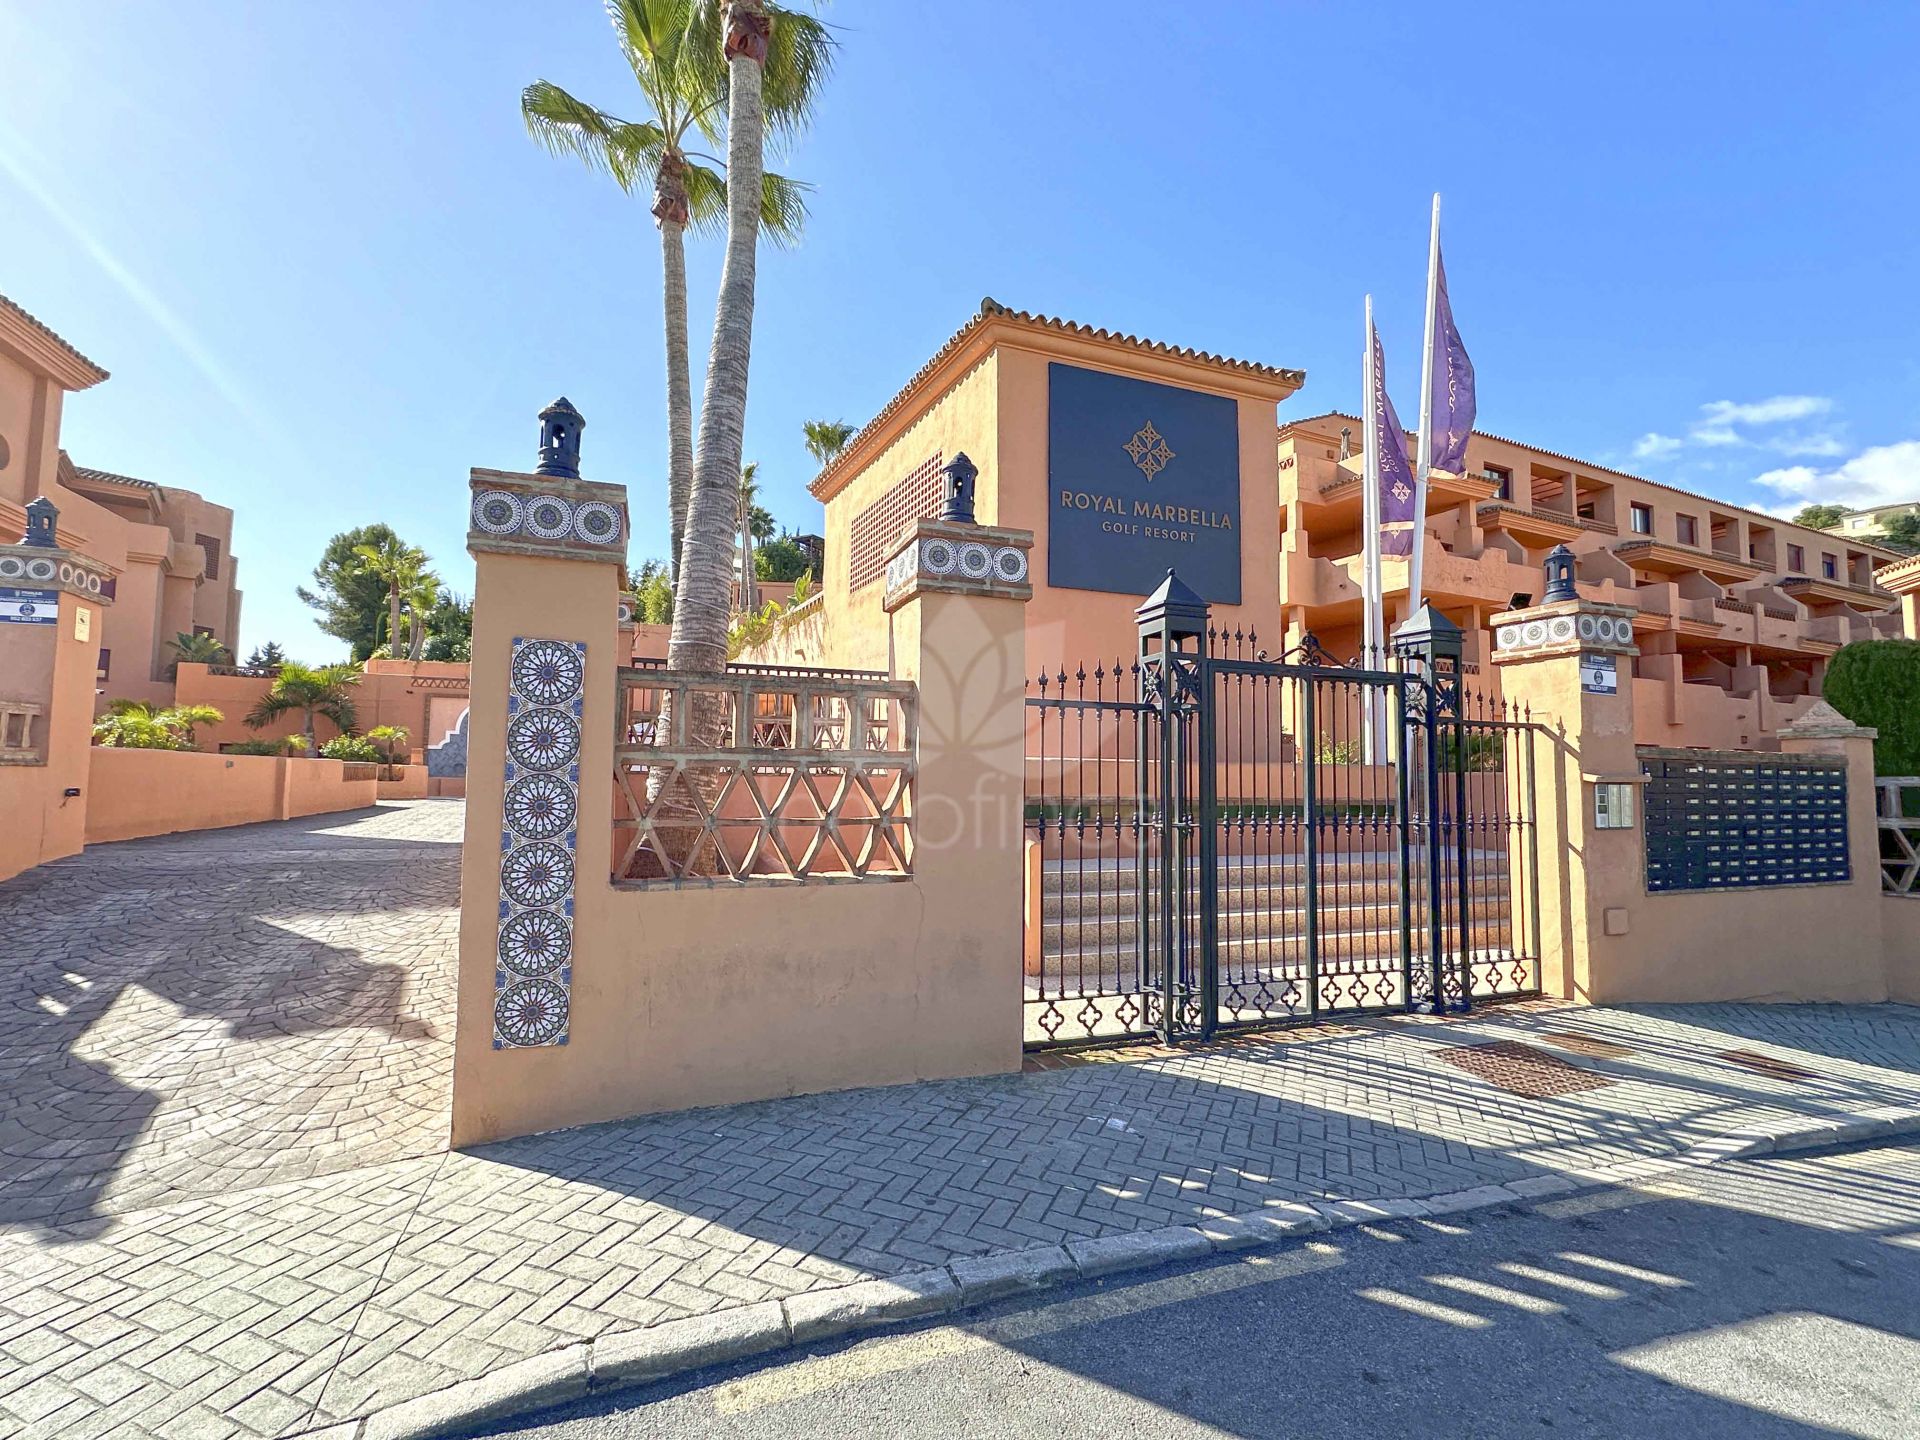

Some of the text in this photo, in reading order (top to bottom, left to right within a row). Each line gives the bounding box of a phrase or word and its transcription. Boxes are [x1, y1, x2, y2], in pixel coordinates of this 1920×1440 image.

[1061, 490, 1233, 530] ROYAL MARBELLA
[1102, 521, 1196, 543] GOLF RESORT
